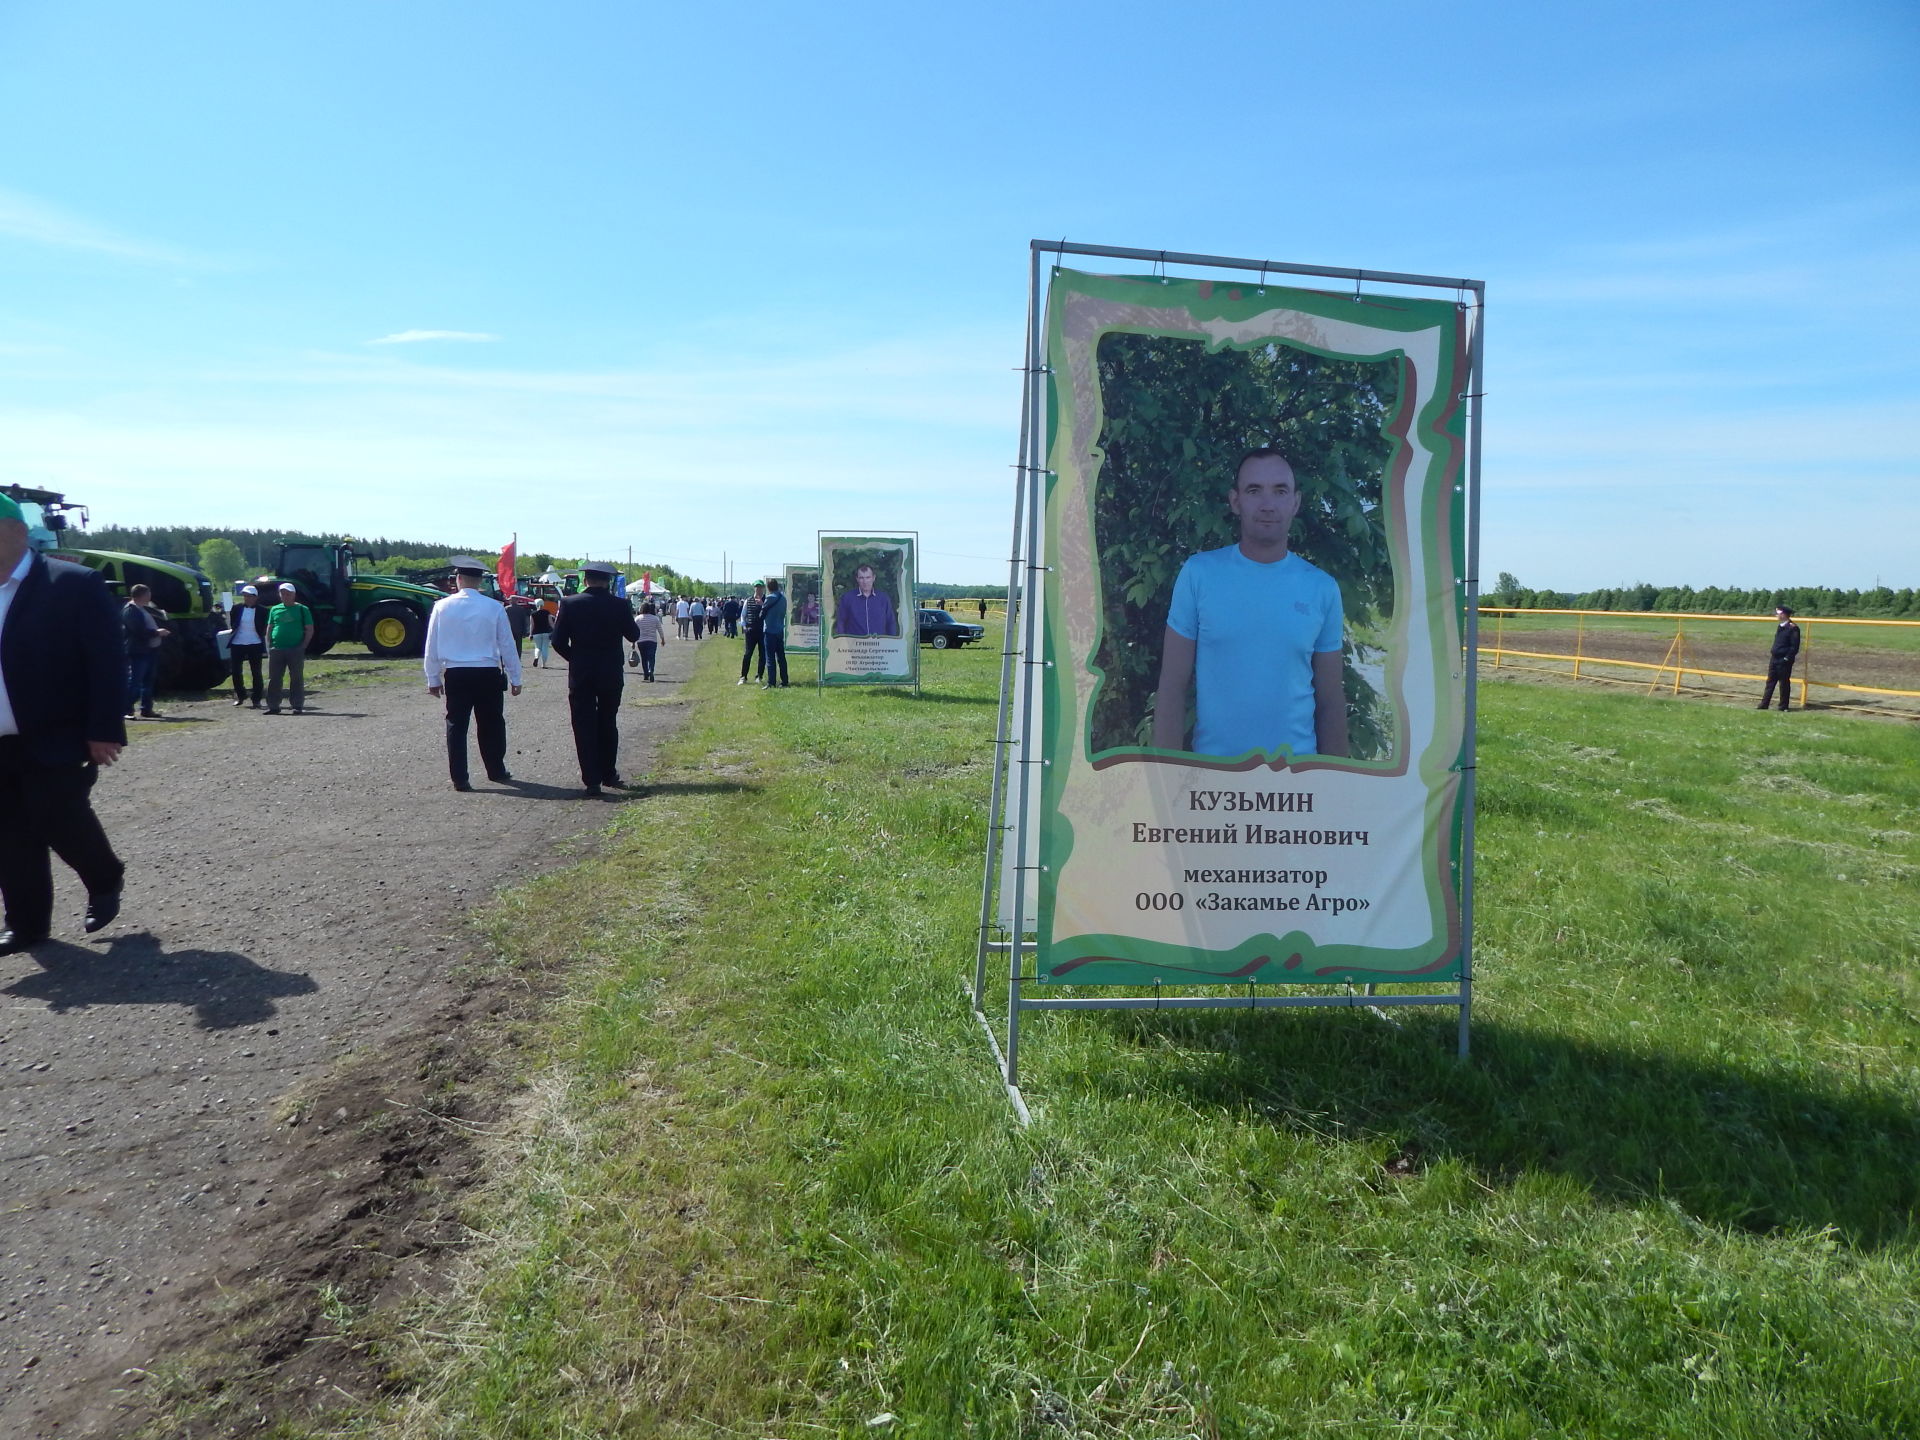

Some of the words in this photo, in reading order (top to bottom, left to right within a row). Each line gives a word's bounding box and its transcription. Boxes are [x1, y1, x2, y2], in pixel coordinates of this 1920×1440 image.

[1189, 790, 1314, 813] КУЗЬМИН
[1132, 822, 1238, 844] Евгений
[1245, 824, 1370, 847] Иванович
[1184, 867, 1329, 889] механизатор
[1135, 892, 1185, 912] ООО
[1195, 892, 1301, 912] «Закамье
[1306, 893, 1371, 916] Агро»
